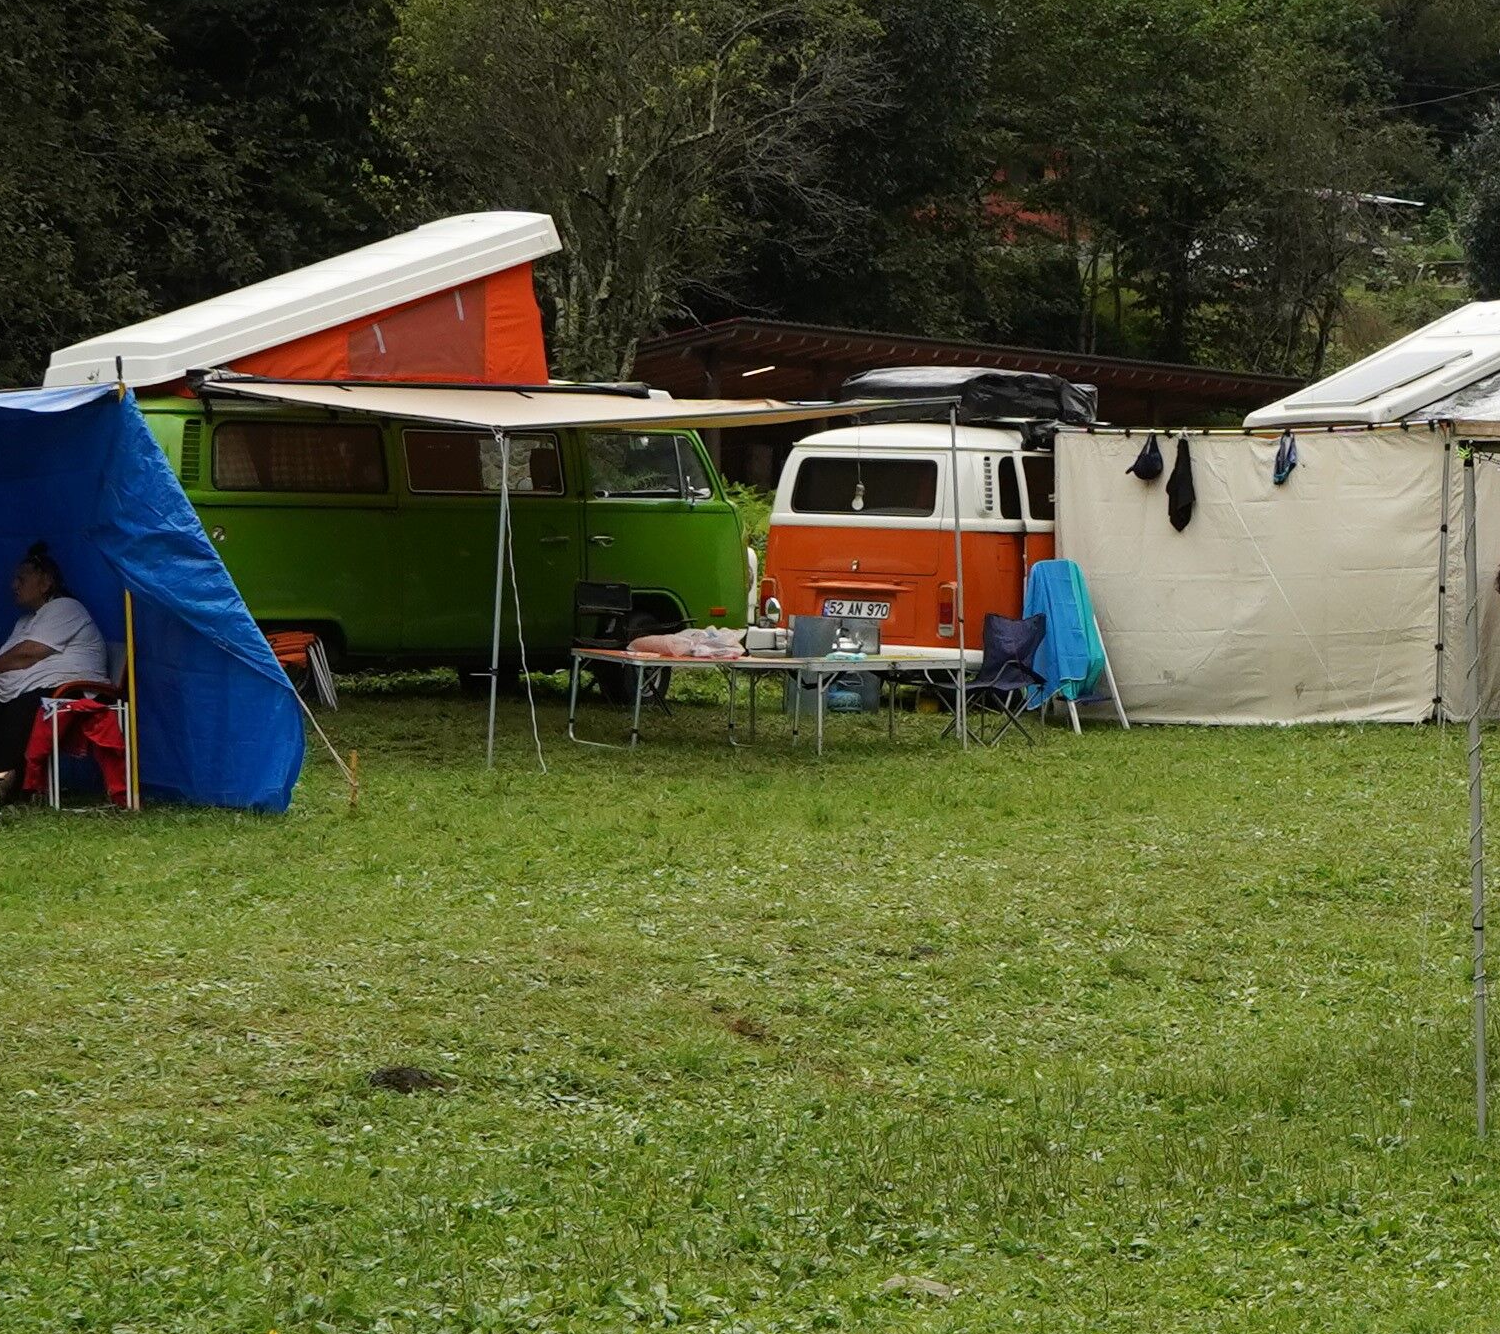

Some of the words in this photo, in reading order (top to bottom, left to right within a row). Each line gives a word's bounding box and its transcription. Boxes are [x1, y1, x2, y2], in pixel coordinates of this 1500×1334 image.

[829, 601, 845, 615] 52
[847, 602, 863, 616] AN
[866, 603, 889, 617] 970
